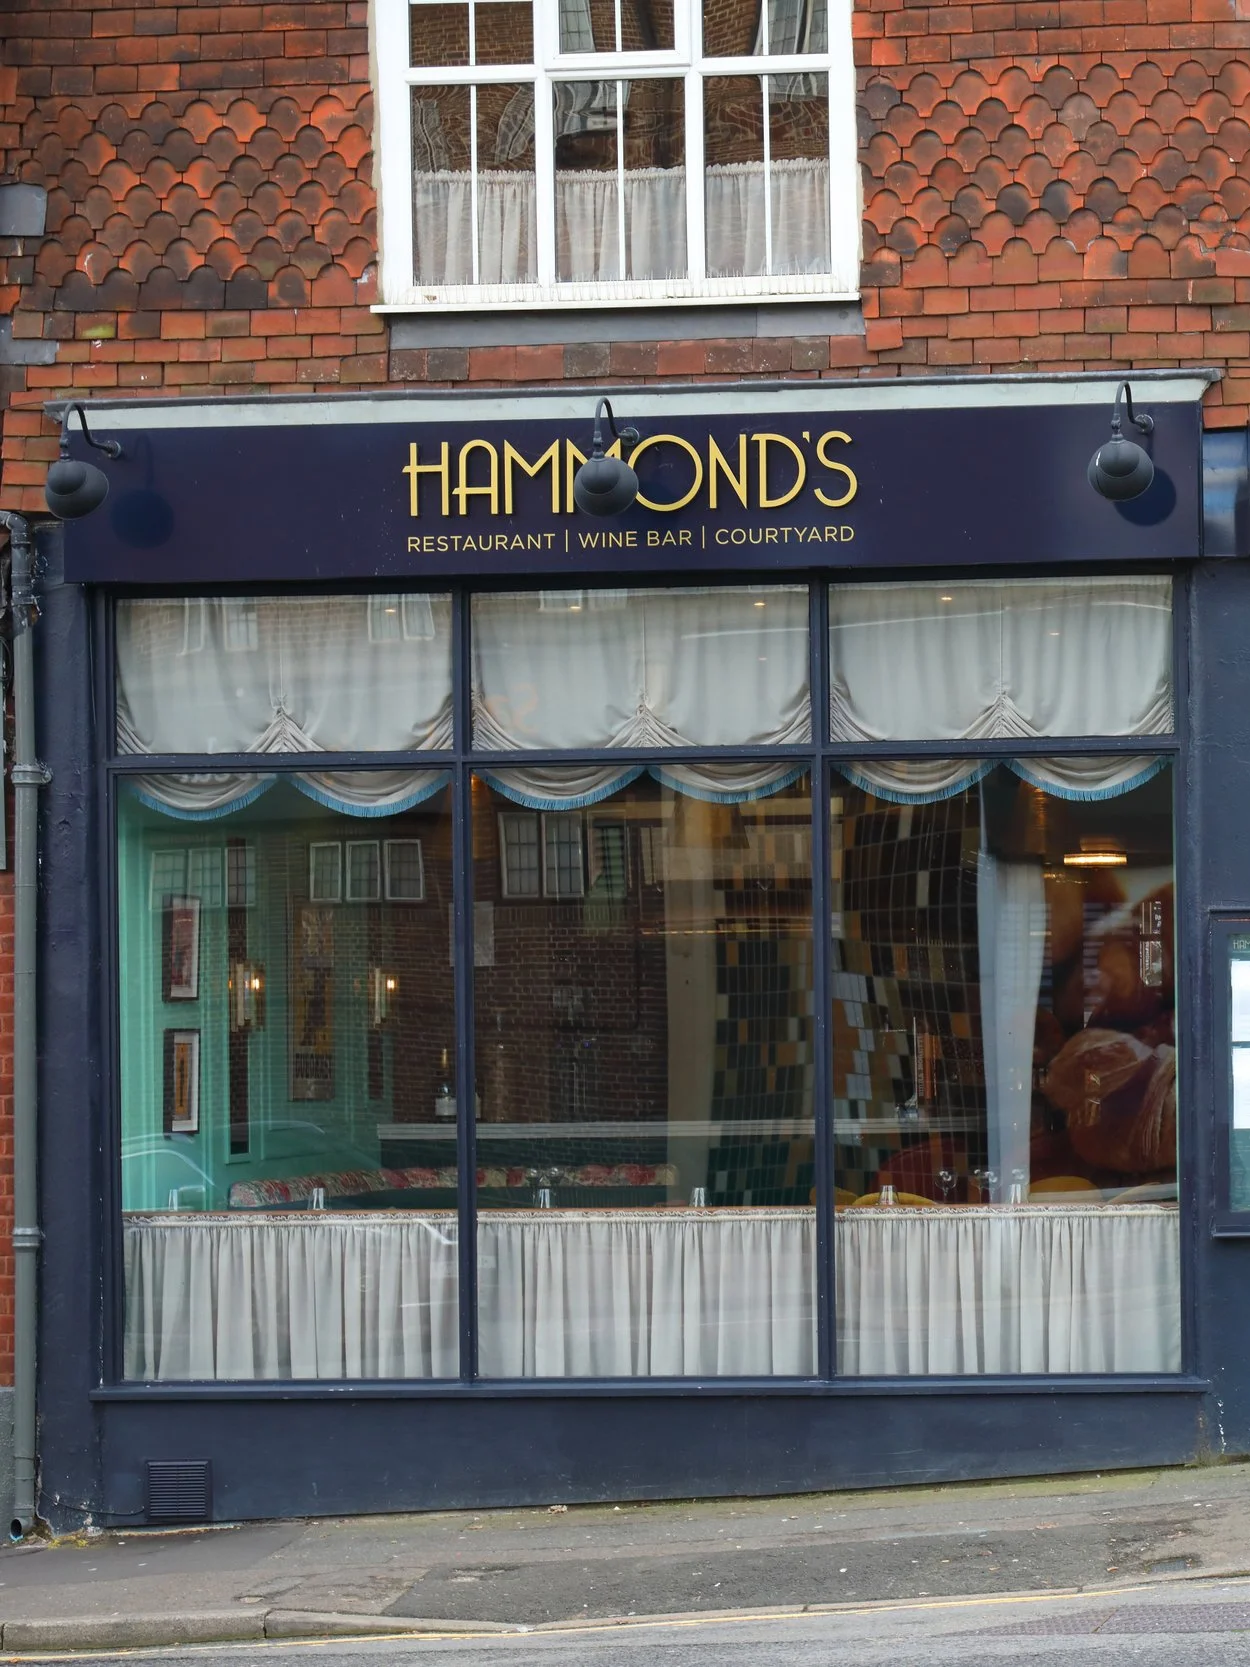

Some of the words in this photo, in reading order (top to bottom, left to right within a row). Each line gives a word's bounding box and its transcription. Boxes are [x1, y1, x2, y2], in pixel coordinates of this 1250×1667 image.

[402, 431, 859, 517] HAMMOND'S
[407, 533, 556, 553] RESTAURANT
[578, 531, 638, 548] WINE
[646, 530, 693, 547] BAR
[715, 526, 856, 546] COURTYARD
